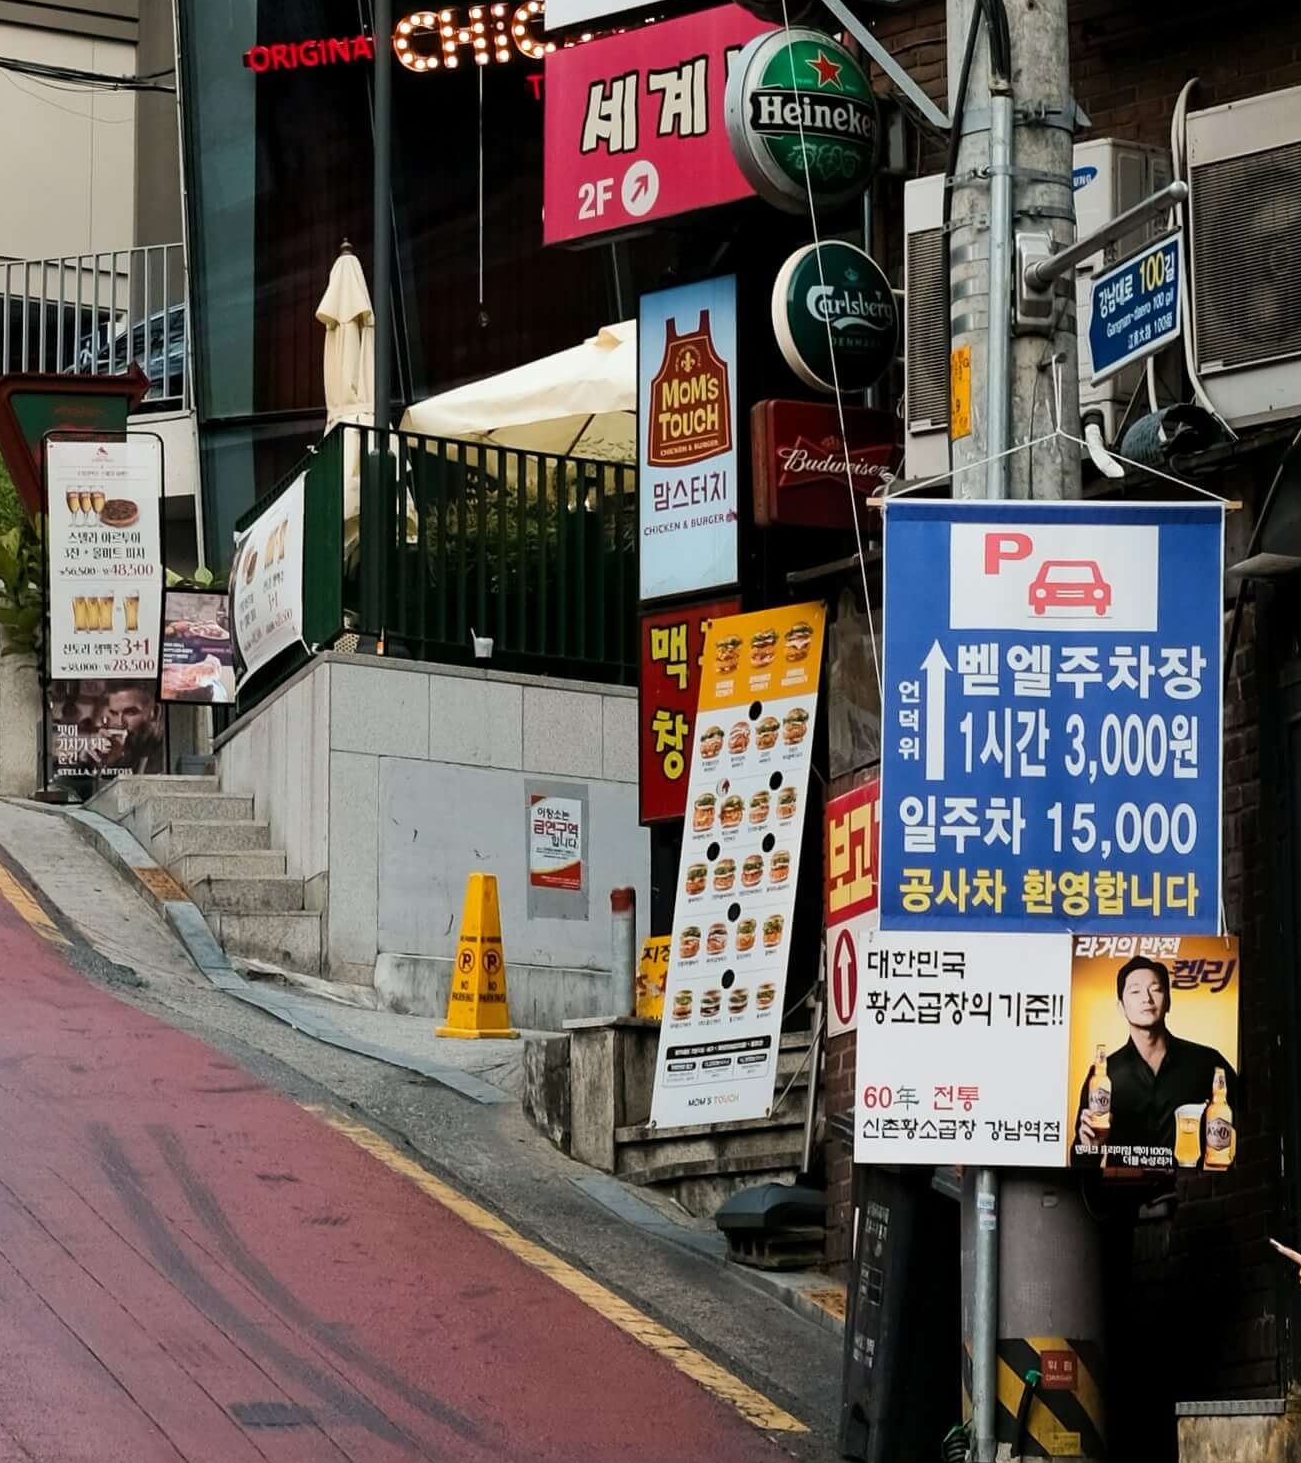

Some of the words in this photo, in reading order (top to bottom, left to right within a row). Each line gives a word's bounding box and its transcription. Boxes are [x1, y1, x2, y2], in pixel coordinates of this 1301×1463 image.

[579, 49, 740, 155] 세계
[578, 177, 614, 221] 2F
[805, 284, 894, 325] Carlsberg
[1098, 273, 1134, 319] 강남대로
[1139, 250, 1176, 295] 100길
[658, 402, 720, 442] TOUCH
[776, 447, 890, 479] Budweiser
[653, 470, 727, 513] 맘스터치
[643, 521, 682, 537] CHICKEN
[690, 513, 725, 529] BURGER
[984, 532, 1034, 576] P
[956, 642, 1207, 701] 벧엘주차장
[897, 679, 921, 761] 언덕위
[958, 707, 1050, 780] 1시간
[1064, 713, 1199, 782] 3,000원
[533, 818, 579, 838] 금연구역
[899, 795, 1026, 856] 일주차
[1045, 801, 1198, 859] 15,000
[898, 866, 1006, 915] 공사차
[1022, 867, 1200, 918] 환영합니다
[866, 949, 967, 980] 대한민국
[1074, 935, 1136, 959] 라거의
[1137, 935, 1182, 960] 반전
[1169, 956, 1238, 994] 켈리
[864, 991, 993, 1028] 황소곱창의
[997, 991, 1066, 1029] 기준!!
[932, 1083, 981, 1112] 전통
[861, 1115, 977, 1143] 신촌황소곱창
[984, 1116, 1061, 1145] 강남역점
